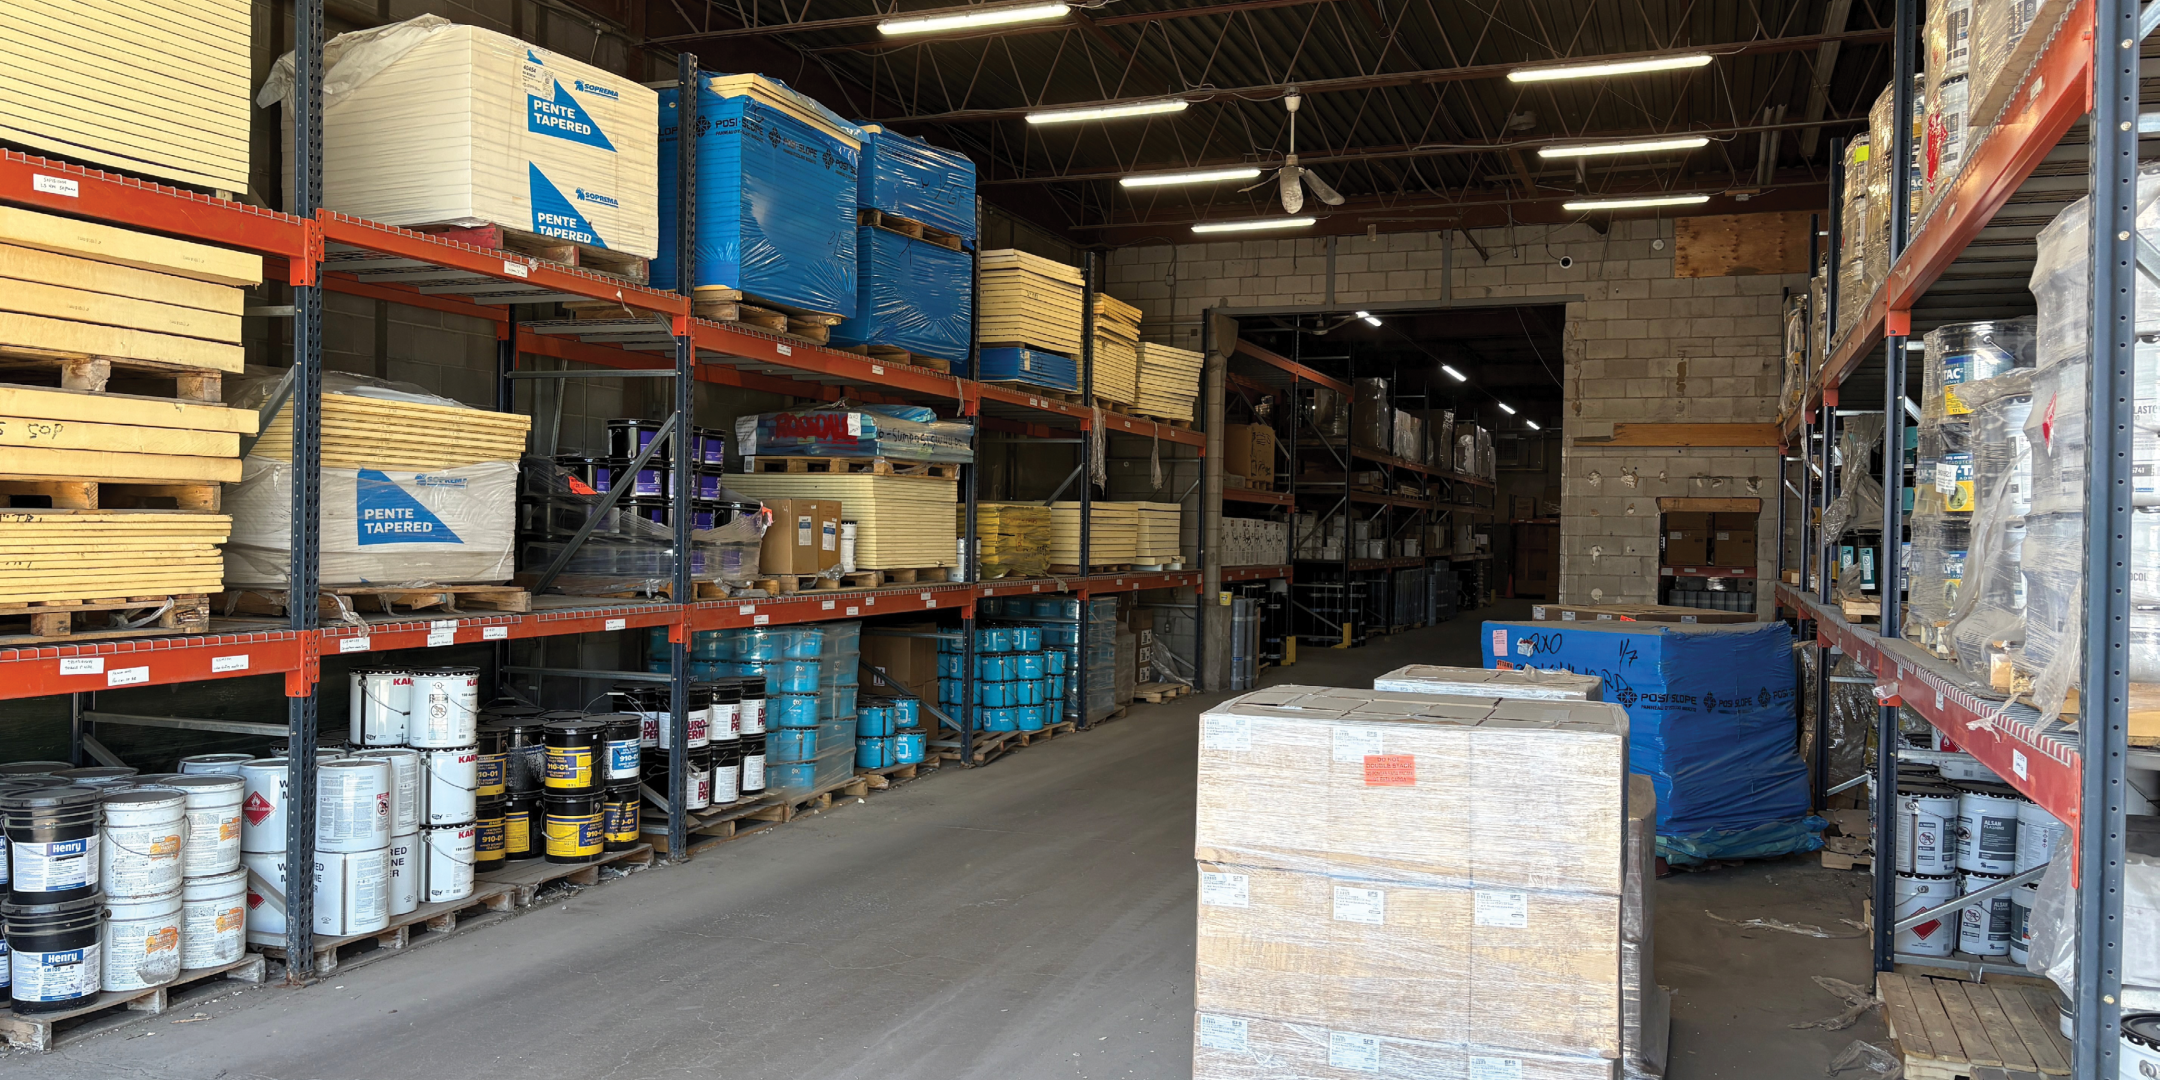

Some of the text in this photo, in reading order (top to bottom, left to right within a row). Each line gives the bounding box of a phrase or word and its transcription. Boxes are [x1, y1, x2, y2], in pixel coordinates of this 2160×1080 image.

[584, 83, 619, 97] SOPREMA
[533, 99, 576, 119] PENTE
[533, 112, 592, 136] TAPERED
[585, 191, 619, 206] SOPREMA
[537, 212, 578, 229] PENTE
[538, 225, 592, 244] TAPERED
[364, 508, 414, 520] PENTE
[364, 522, 433, 534] TAPERED
[52, 842, 82, 854] Henry
[48, 952, 78, 964] Henry
